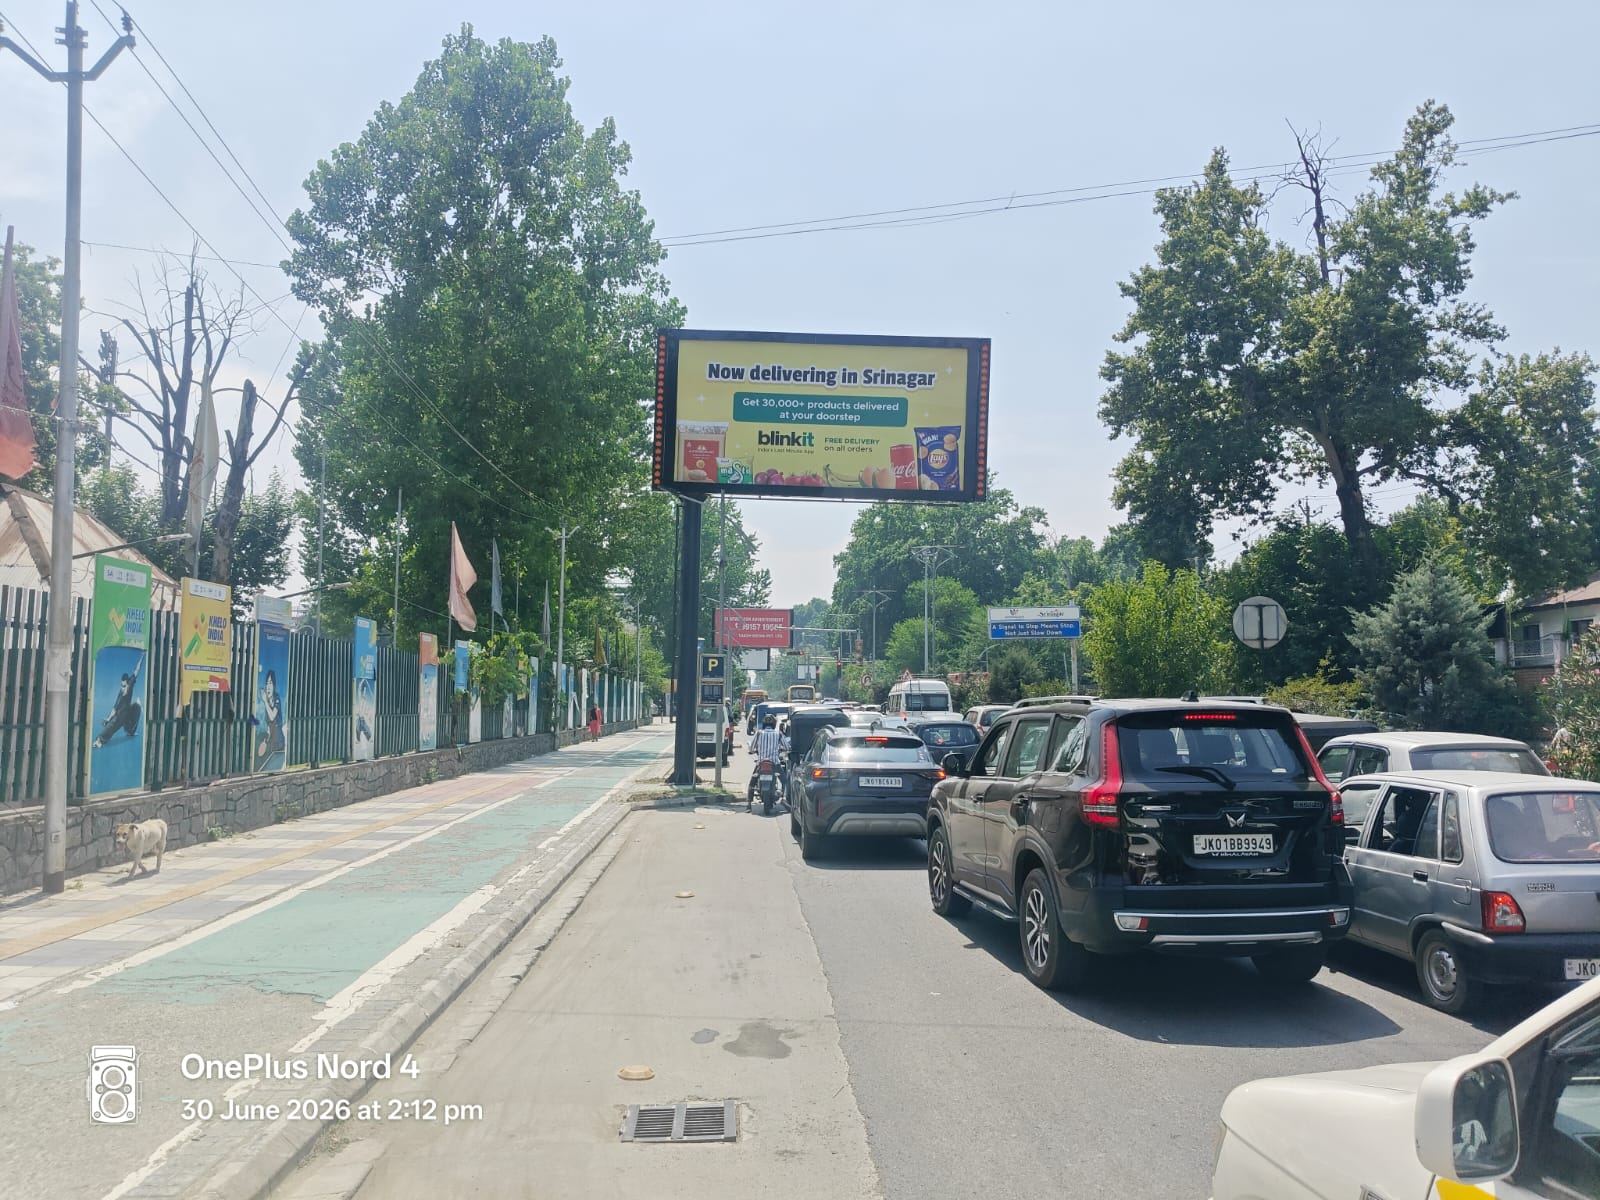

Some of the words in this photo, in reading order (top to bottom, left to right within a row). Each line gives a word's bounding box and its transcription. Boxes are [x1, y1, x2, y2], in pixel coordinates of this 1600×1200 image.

[708, 364, 744, 380] Now
[750, 365, 837, 386] delivering
[842, 368, 858, 384] in
[863, 369, 935, 388] Srinagar
[742, 398, 759, 407] Get
[762, 399, 804, 408] 30,000+
[808, 400, 850, 411] products
[853, 402, 899, 411] delivered
[792, 413, 814, 421] your
[816, 412, 860, 422] doorstep
[758, 430, 814, 447] blinkit
[209, 616, 226, 628] KHELO
[208, 628, 224, 640] INDIA
[708, 658, 718, 672] P
[1201, 838, 1272, 850] JK01BB9949
[1576, 962, 1600, 976] JK0
